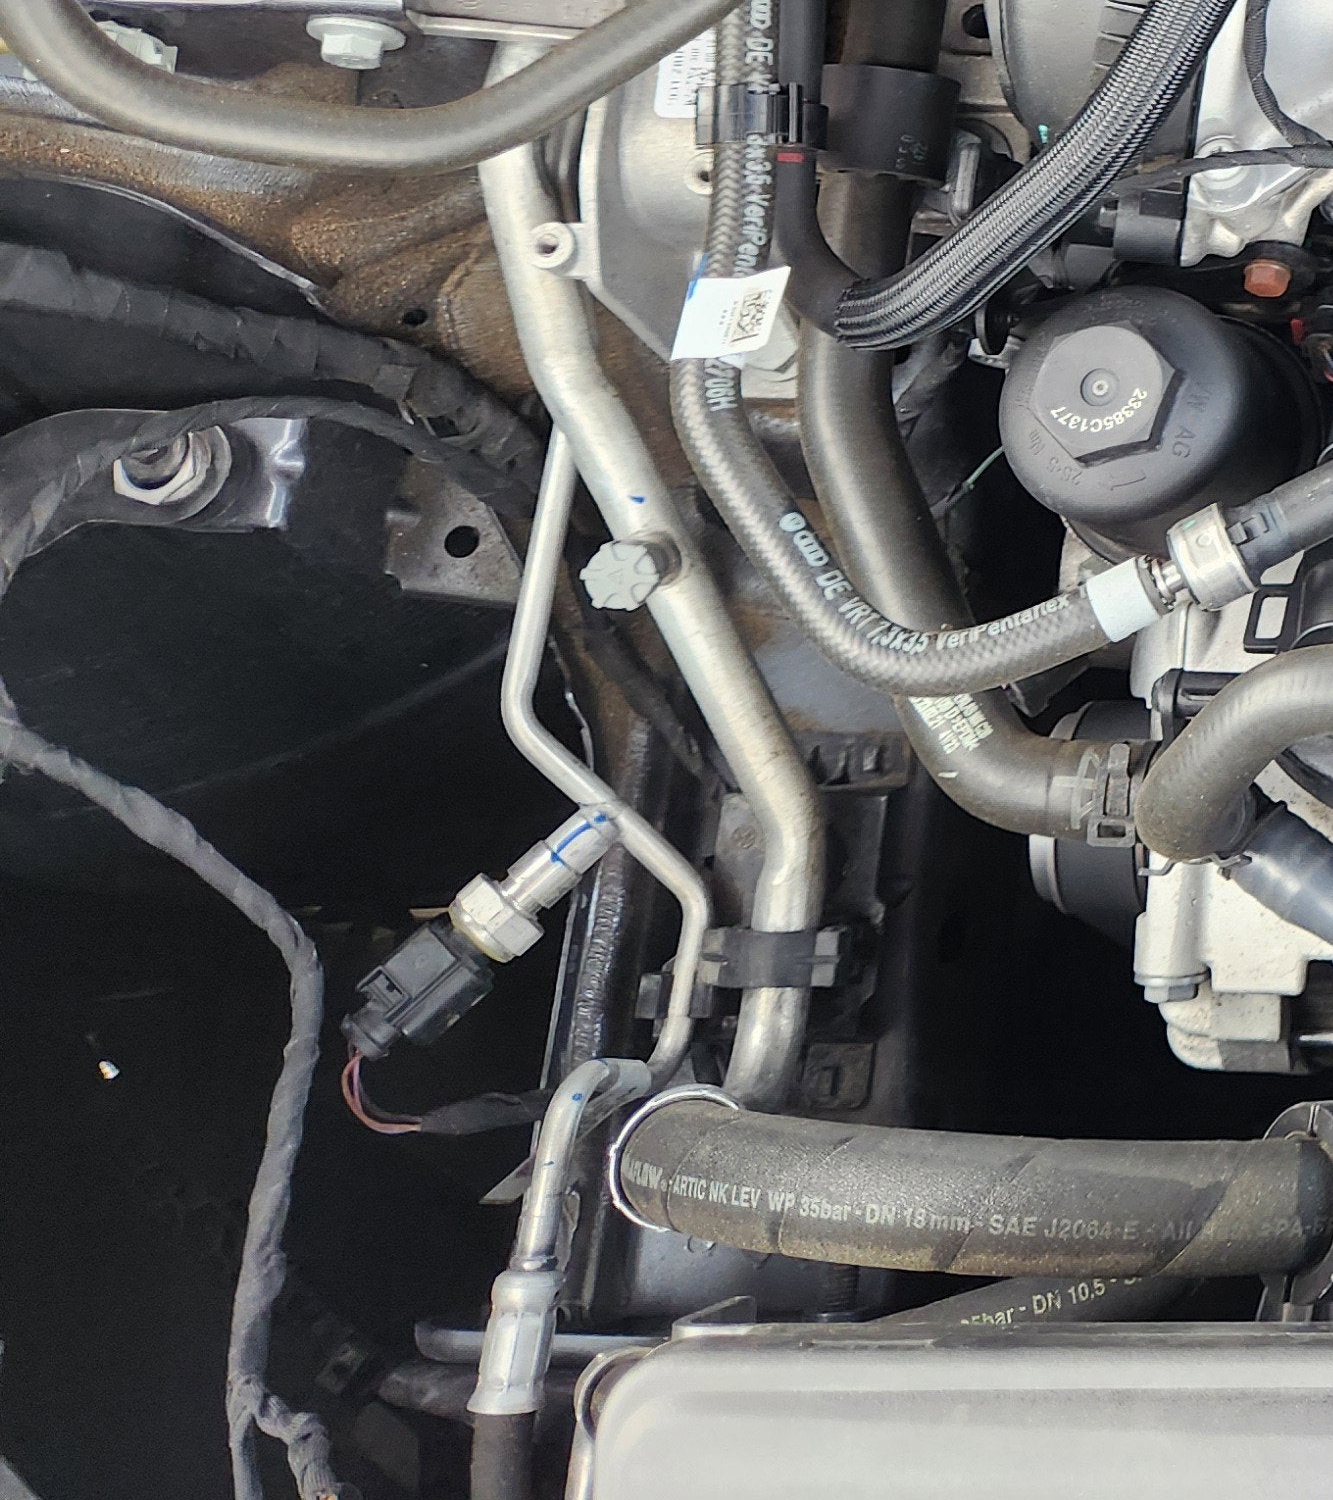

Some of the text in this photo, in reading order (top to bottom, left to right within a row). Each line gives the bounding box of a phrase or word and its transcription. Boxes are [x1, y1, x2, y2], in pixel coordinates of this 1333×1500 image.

[816, 570, 853, 601] DE
[838, 596, 880, 631] VRT
[673, 1175, 707, 1200] ARTIC
[708, 1180, 730, 1204] NK
[731, 1185, 761, 1209] LEV
[767, 1190, 797, 1213] WP
[800, 1196, 850, 1221] 35bar
[865, 1203, 896, 1225] DN
[987, 1214, 1040, 1237] SAE
[1032, 1292, 1063, 1316] DN
